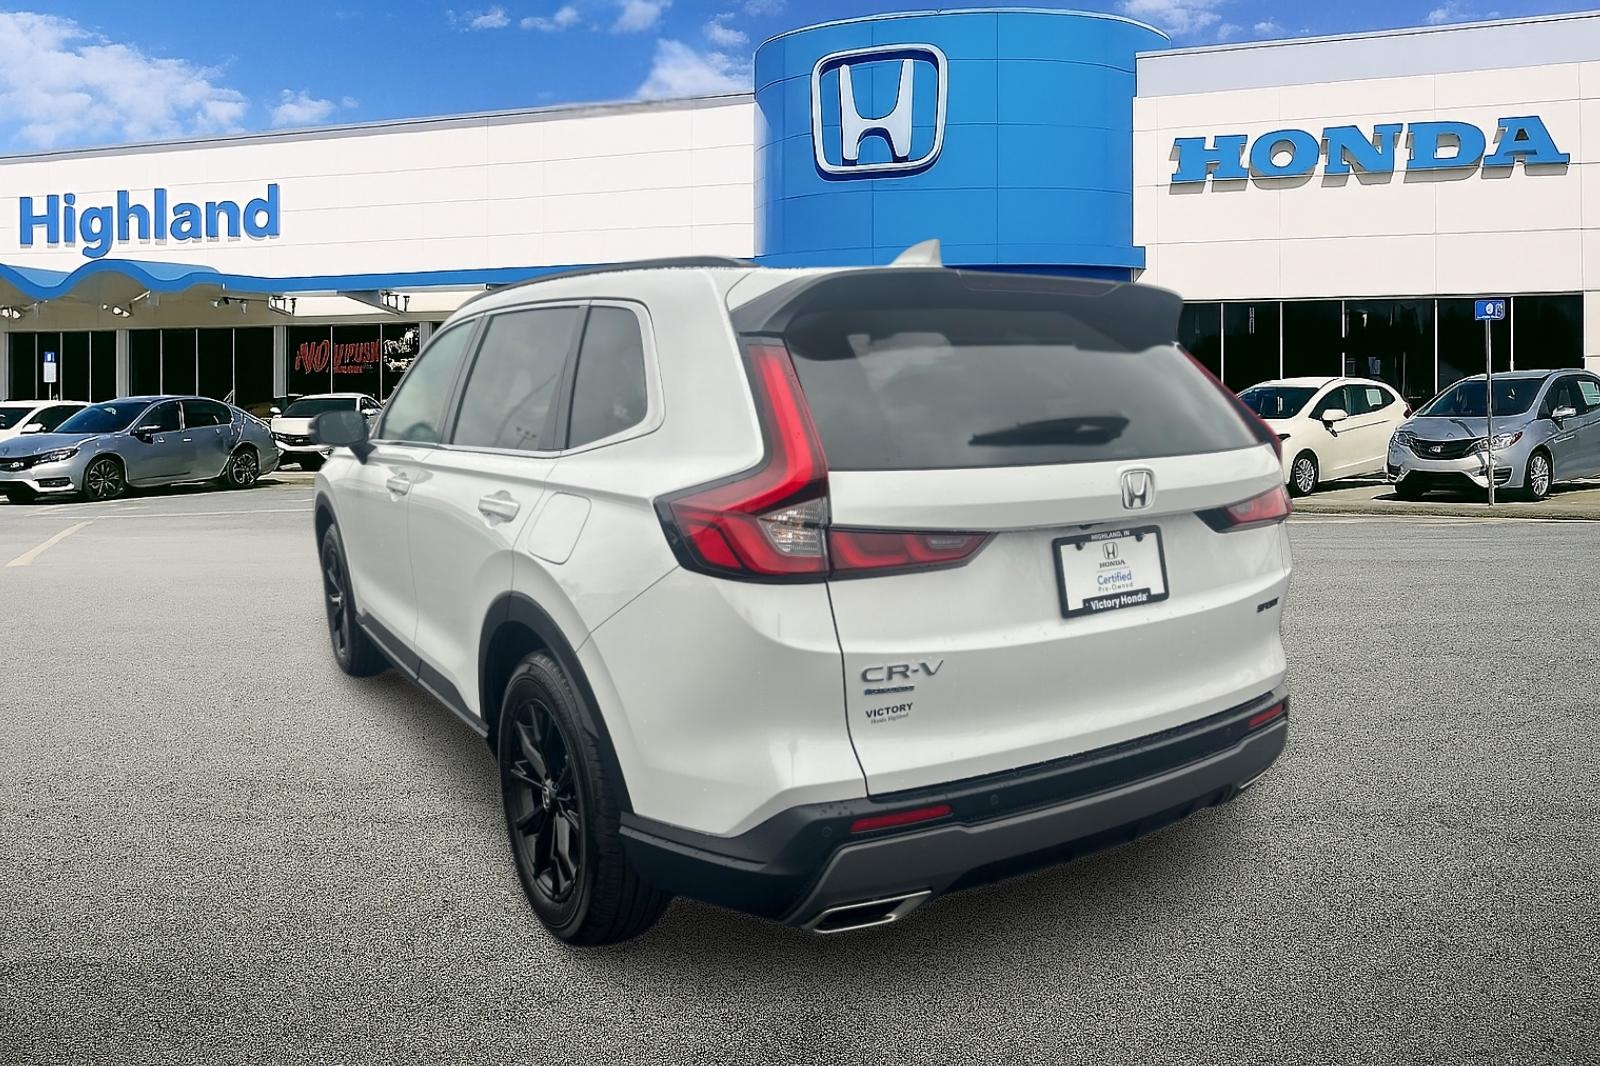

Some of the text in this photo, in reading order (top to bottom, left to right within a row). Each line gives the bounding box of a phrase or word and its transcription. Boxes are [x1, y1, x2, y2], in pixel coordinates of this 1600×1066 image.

[1170, 115, 1570, 187] HONDA
[19, 183, 281, 258] Highland
[1099, 559, 1126, 569] HONDA
[1097, 571, 1132, 585] Certified
[1098, 582, 1134, 592] Pre-Owned
[1090, 593, 1147, 611] Victory Honda
[861, 659, 944, 683] CR-V
[865, 702, 914, 718] VICTORY
